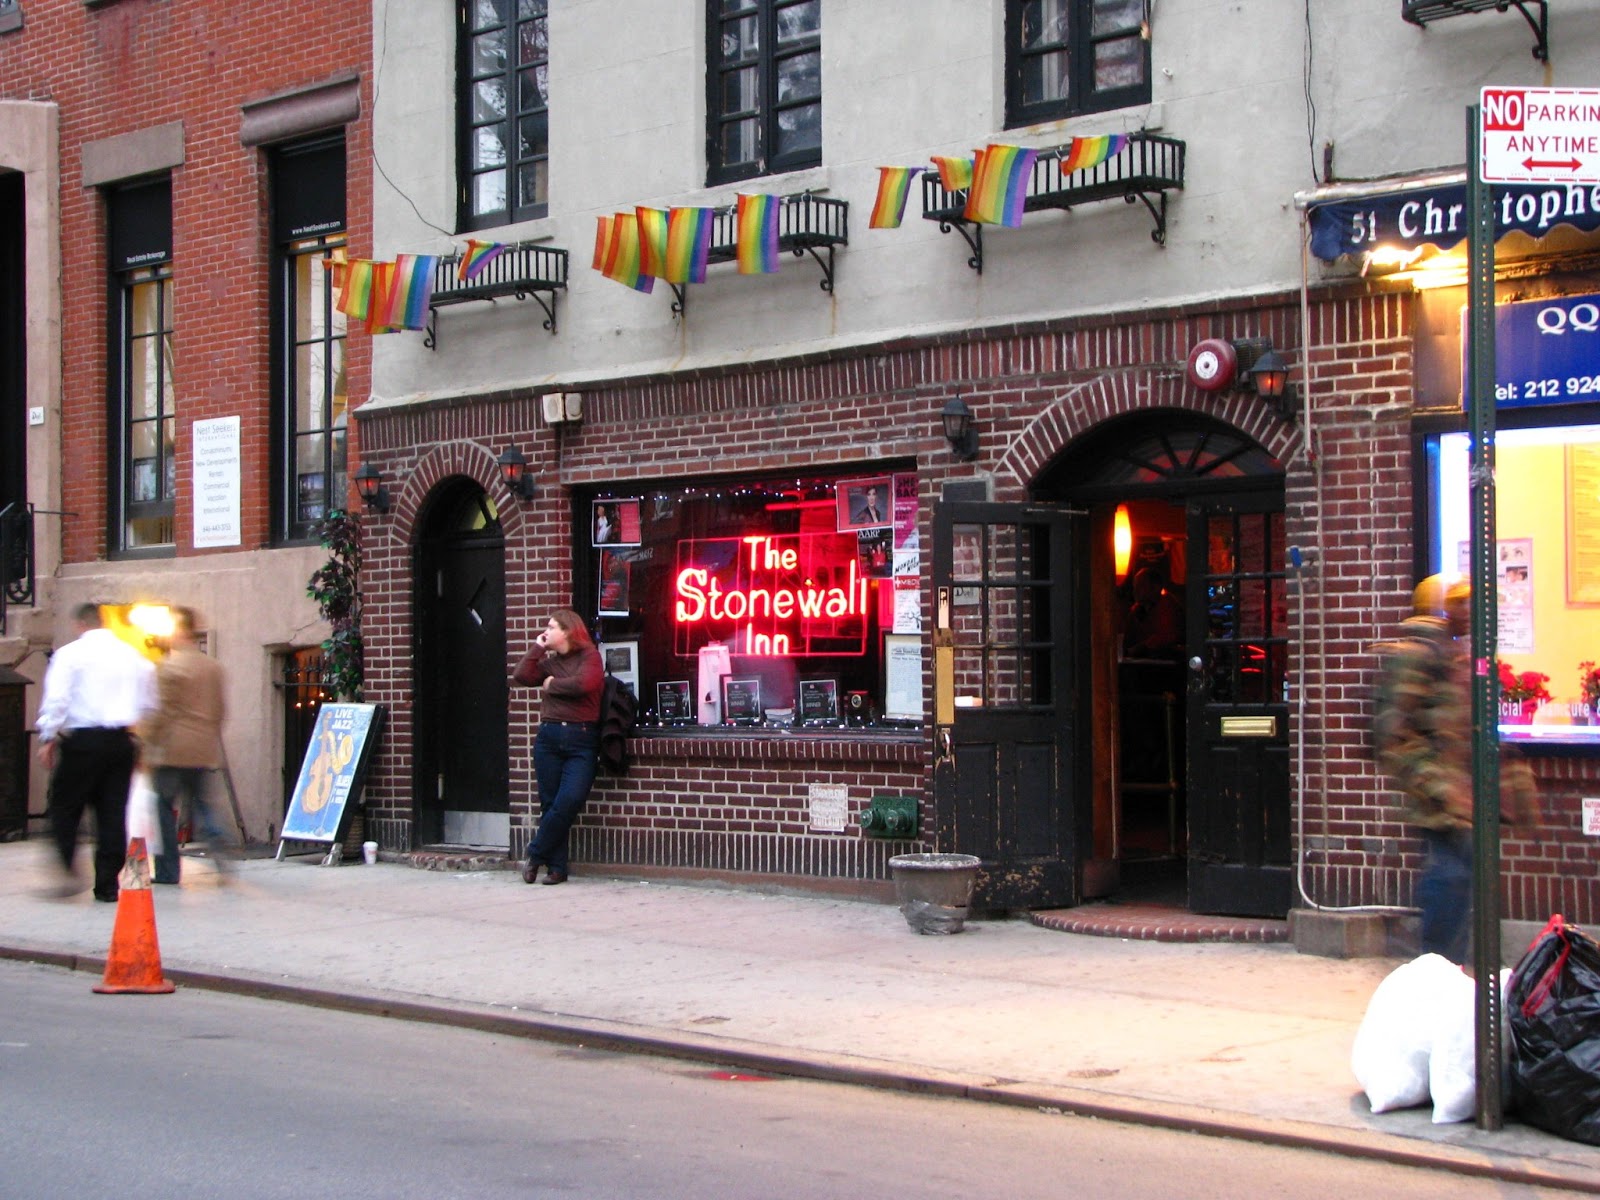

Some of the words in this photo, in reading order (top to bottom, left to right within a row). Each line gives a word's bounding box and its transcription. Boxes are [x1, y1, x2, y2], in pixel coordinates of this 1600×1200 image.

[1486, 94, 1523, 126] NO
[1527, 104, 1600, 122] PARKIN
[1506, 135, 1599, 153] ANYTIME
[1351, 211, 1376, 244] 51
[1536, 303, 1600, 335] QQ
[1495, 382, 1517, 401] el:
[1524, 379, 1559, 399] 212
[1566, 375, 1600, 395] 924
[743, 536, 798, 571] The
[676, 558, 867, 622] Stonewall
[745, 622, 790, 656] Inn
[332, 720, 352, 729] JAZZ
[335, 709, 354, 719] LIVE
